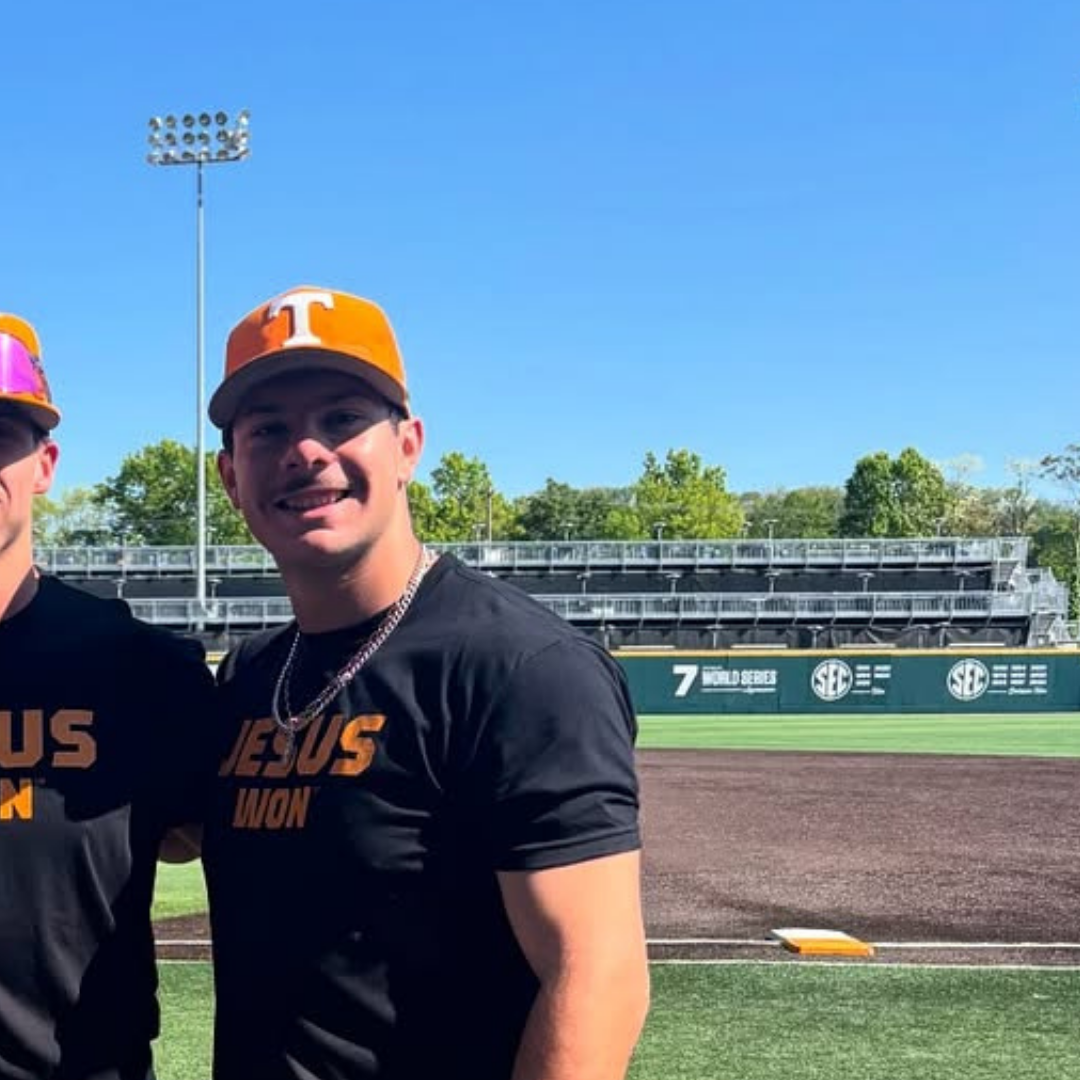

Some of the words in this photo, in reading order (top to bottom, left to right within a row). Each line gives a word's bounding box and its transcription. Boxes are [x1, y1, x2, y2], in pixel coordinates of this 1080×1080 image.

[269, 292, 334, 347] T
[673, 664, 699, 697] 7
[815, 663, 848, 697] SEC
[951, 662, 984, 696] SEC
[218, 713, 387, 776] JESUS
[232, 785, 312, 829] WON
